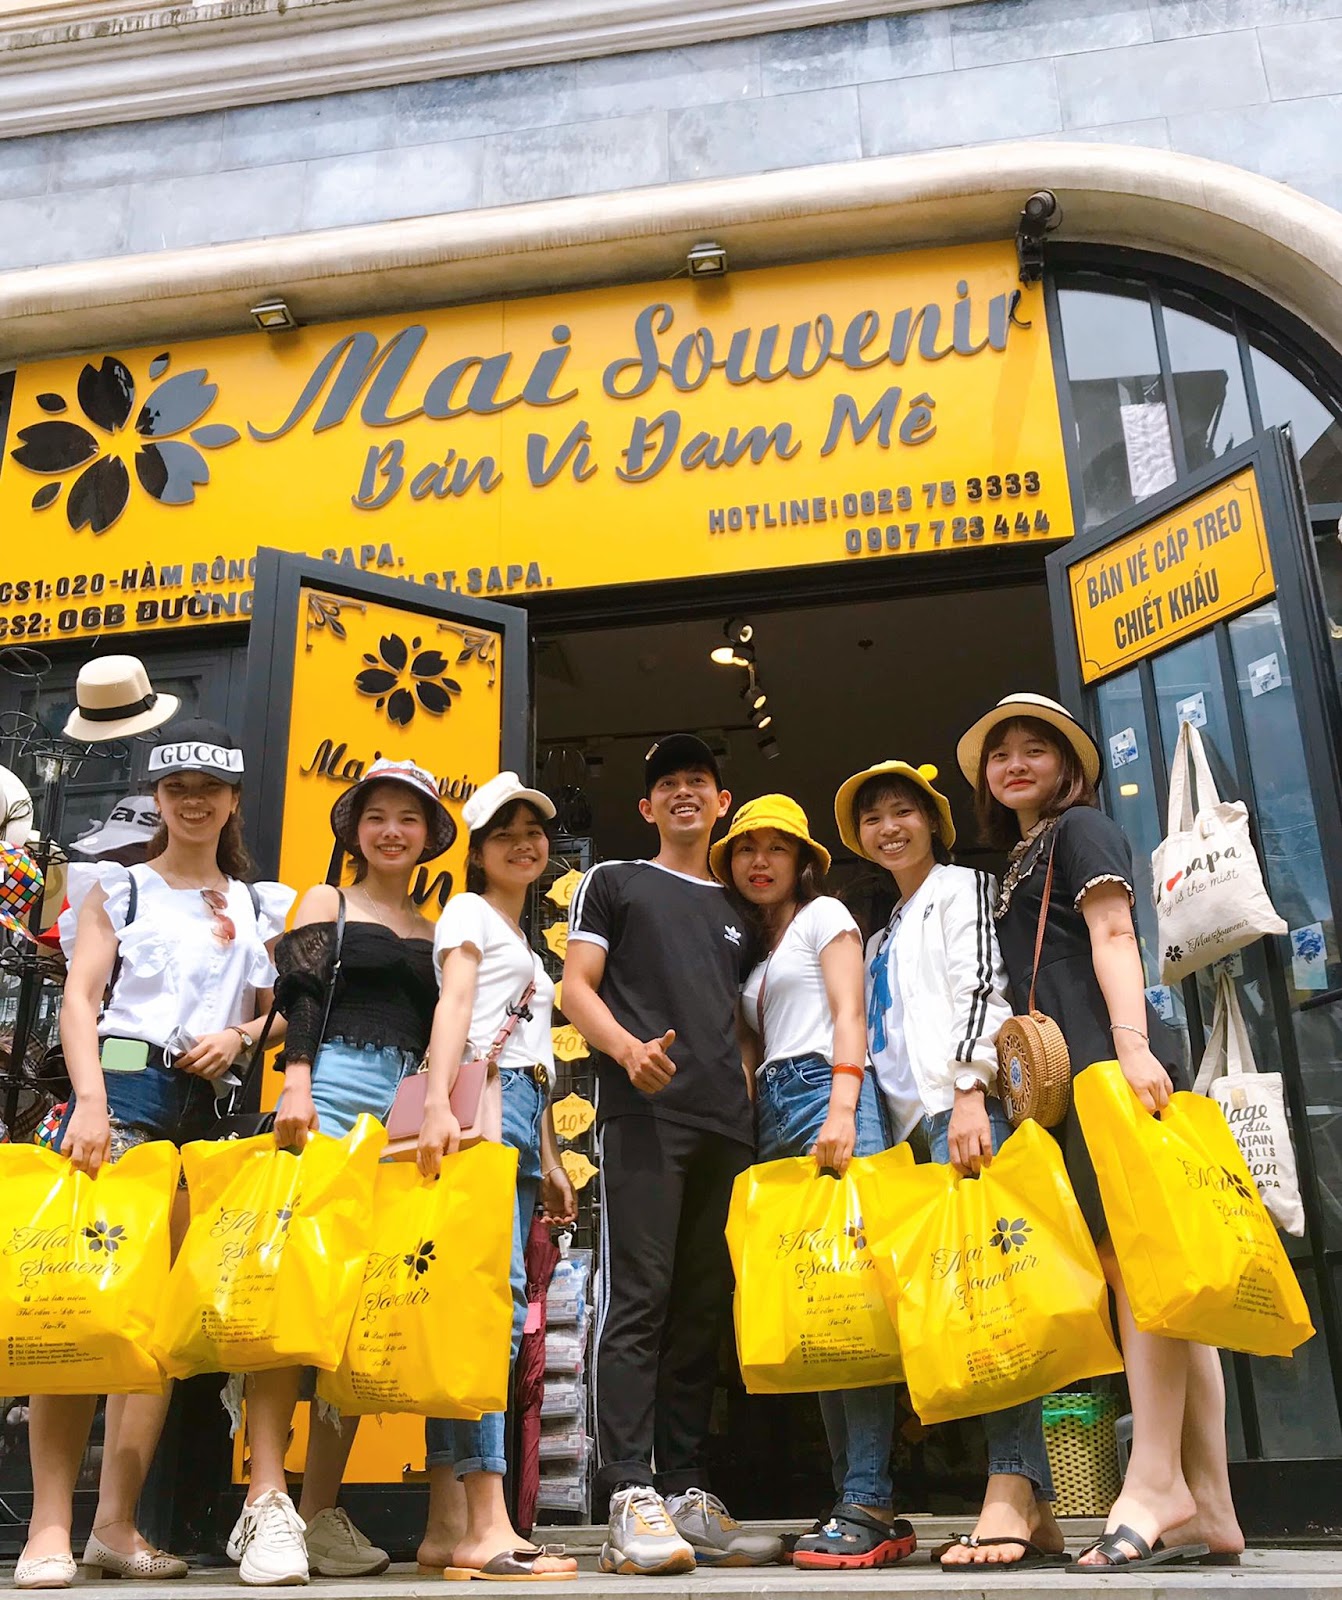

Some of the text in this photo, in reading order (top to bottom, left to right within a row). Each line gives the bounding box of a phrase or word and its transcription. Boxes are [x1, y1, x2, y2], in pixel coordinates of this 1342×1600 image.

[247, 279, 1032, 441] Mai Souvenir
[352, 438, 503, 510] Bán
[615, 410, 802, 482] Đam
[820, 386, 937, 456] Mê
[922, 480, 956, 507] 75
[966, 470, 1042, 501] 3333
[993, 509, 1050, 537] 444
[1086, 499, 1242, 609] BÁN VÉ CÁP TREO
[1114, 562, 1220, 650] CHIẾT KHẤU
[160, 744, 233, 768] GUCCI
[300, 738, 382, 784] Ma
[557, 1112, 588, 1133] 10K
[1217, 1101, 1268, 1127] lage
[1236, 1134, 1274, 1149] NTAIN
[1256, 1180, 1281, 1189] APA
[3, 1224, 74, 1256] Mai
[776, 1228, 837, 1260] Mai
[17, 1253, 123, 1289] Souvenir
[794, 1254, 876, 1290] Souven
